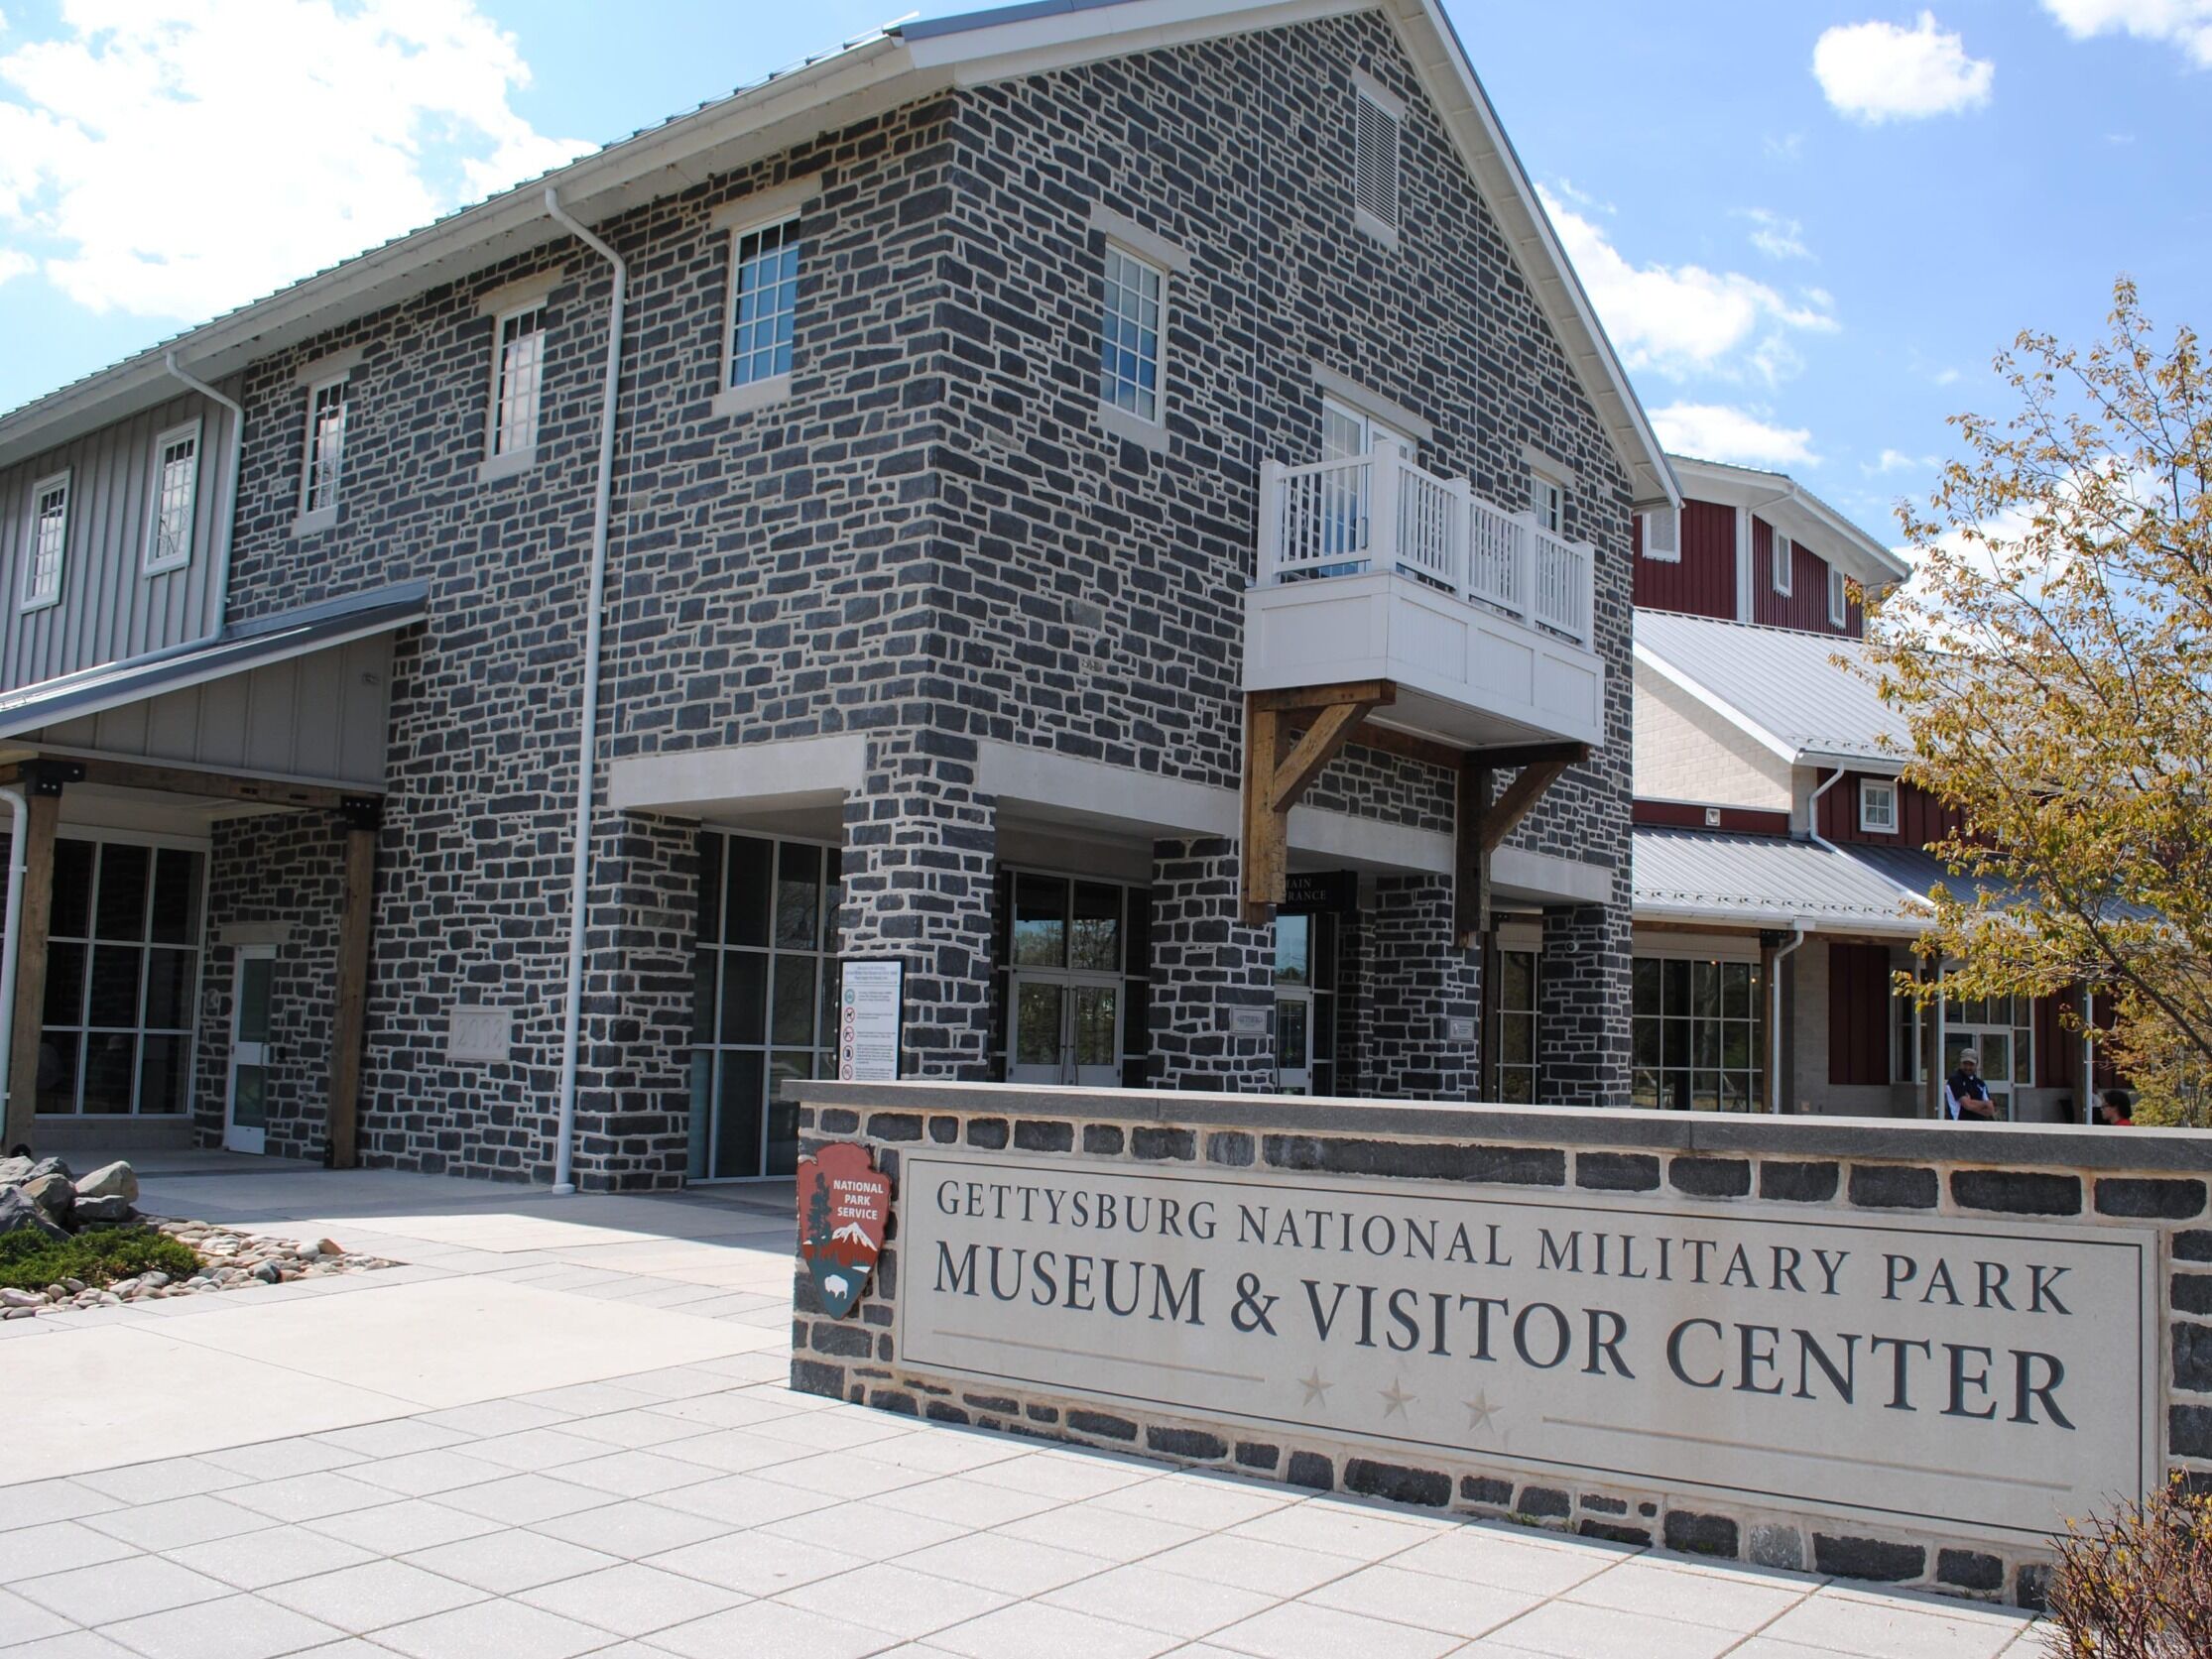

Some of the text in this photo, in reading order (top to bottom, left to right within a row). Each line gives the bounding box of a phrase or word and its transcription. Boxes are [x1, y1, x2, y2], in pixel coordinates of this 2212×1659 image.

[833, 1179, 883, 1193] NATIONAL
[844, 1194, 871, 1206] PARK
[837, 1207, 877, 1220] SERVICE
[936, 1180, 2073, 1316] GETTYSBURG NATIONAL MILITARY PARK
[932, 1240, 2076, 1431] MUSEUM & VISITOR CENTER
